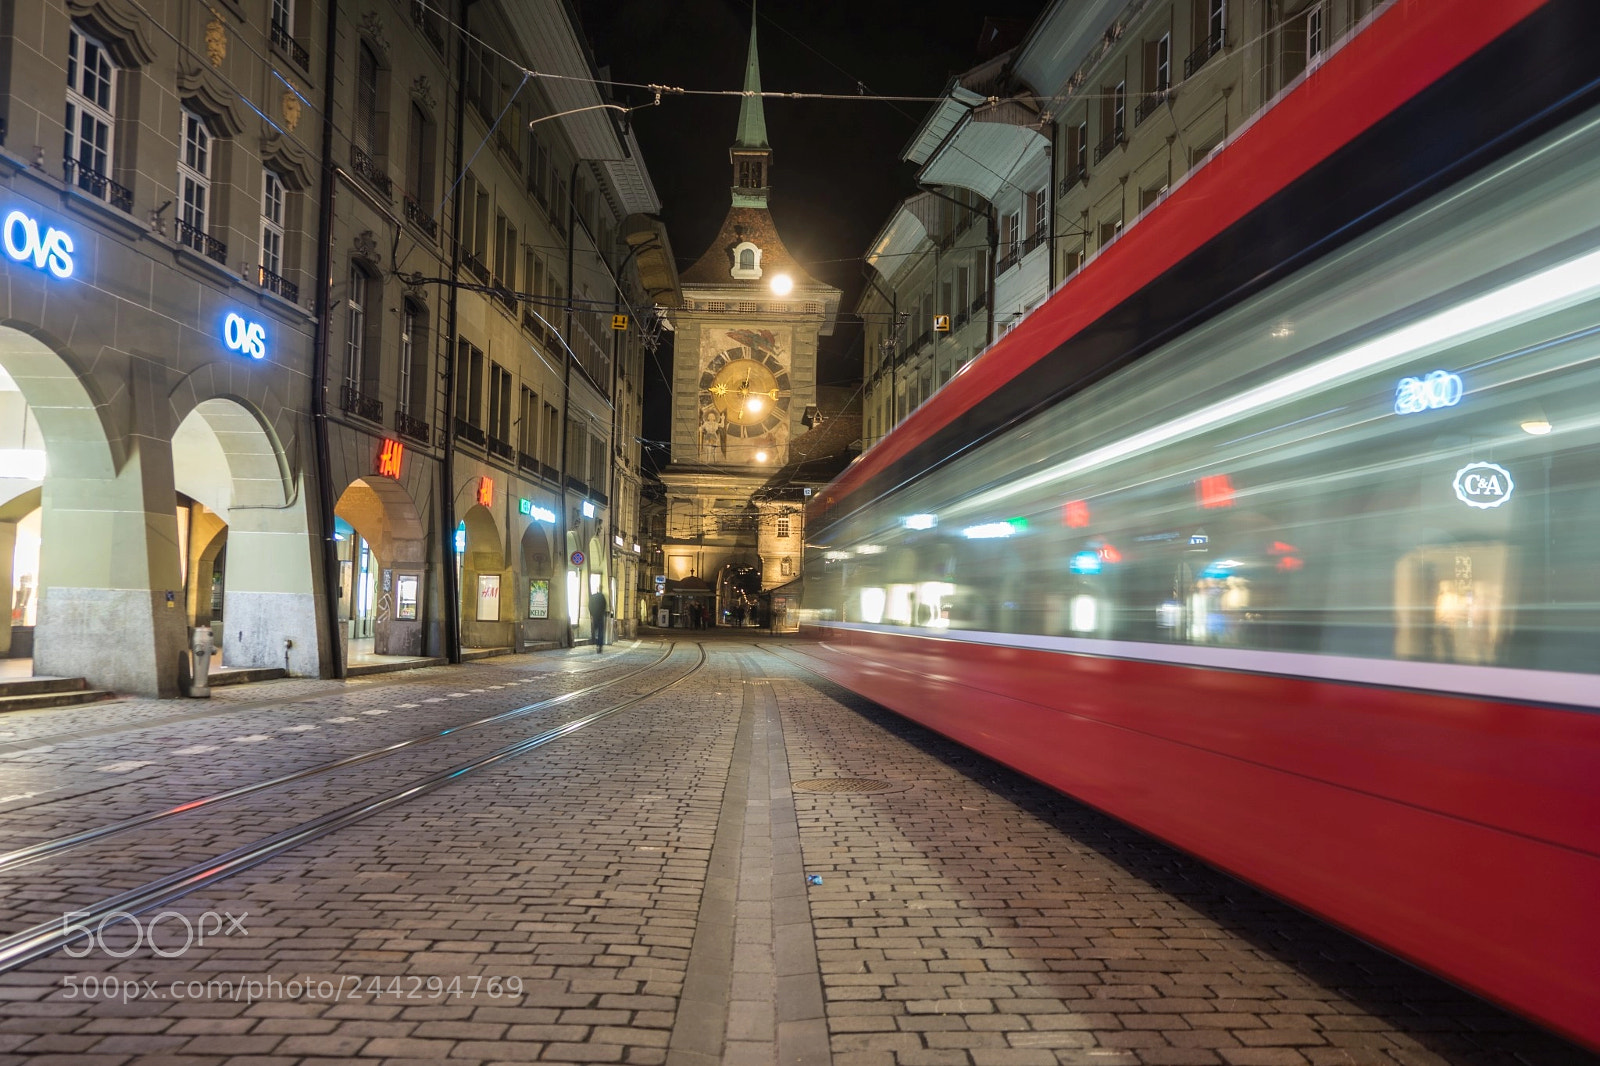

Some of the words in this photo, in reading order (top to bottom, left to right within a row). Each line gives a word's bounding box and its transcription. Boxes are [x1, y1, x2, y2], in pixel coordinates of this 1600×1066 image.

[4, 211, 73, 278] OVS
[225, 313, 266, 358] OVS
[1465, 474, 1503, 495] C&A
